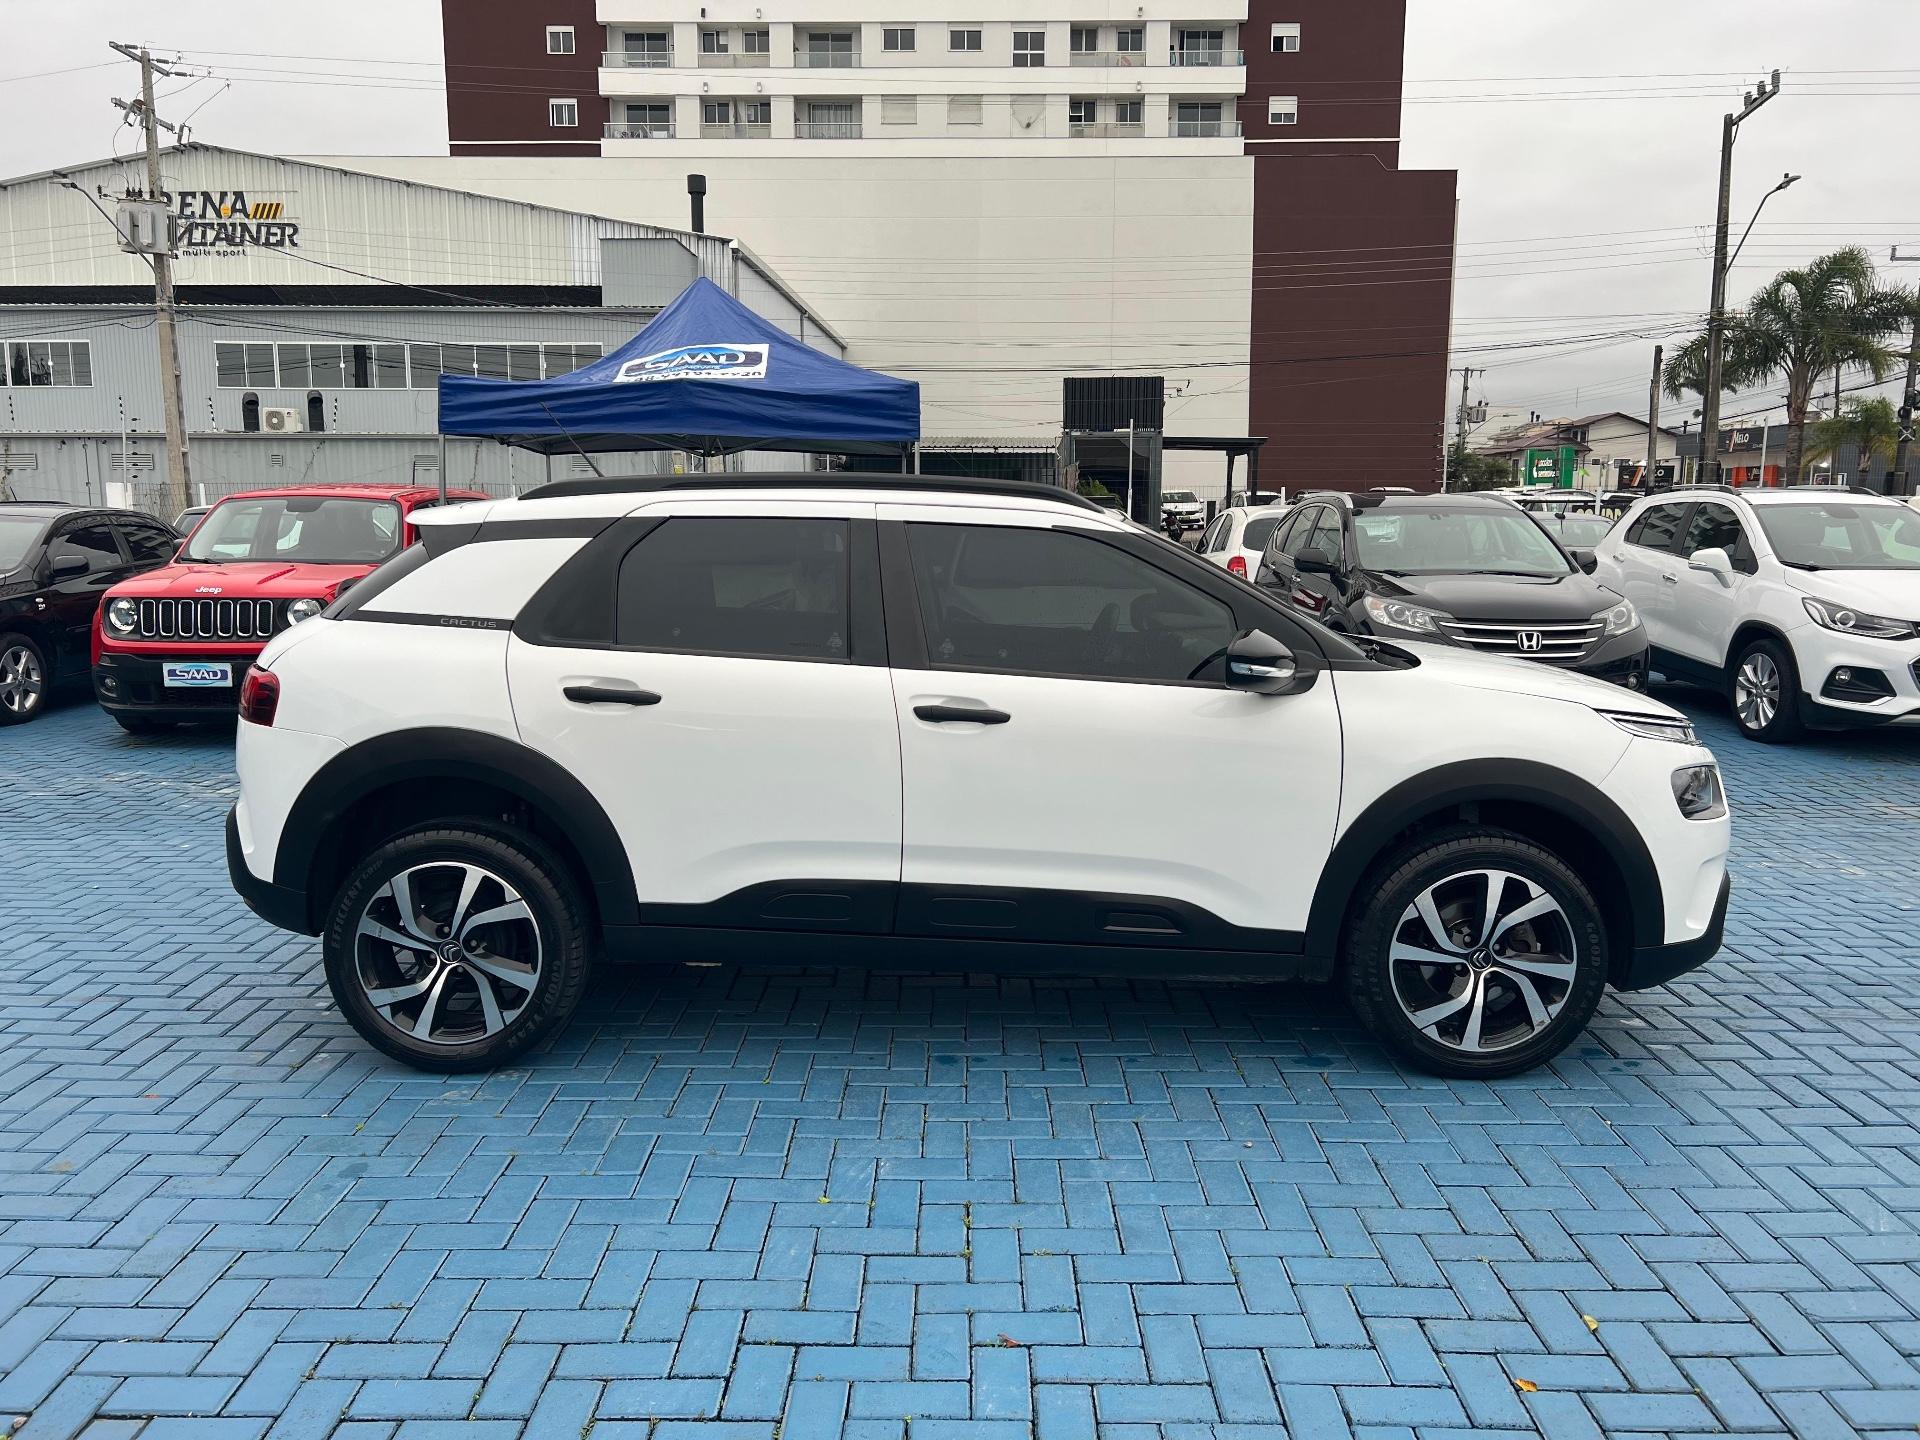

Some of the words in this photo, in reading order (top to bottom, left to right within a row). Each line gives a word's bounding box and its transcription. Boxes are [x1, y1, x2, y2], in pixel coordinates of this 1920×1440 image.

[182, 248, 211, 257] multi
[215, 248, 247, 259] sport
[644, 351, 746, 369] SAAD
[195, 585, 223, 595] Jeep
[440, 618, 497, 628] CACTUS
[176, 668, 221, 680] SAAD
